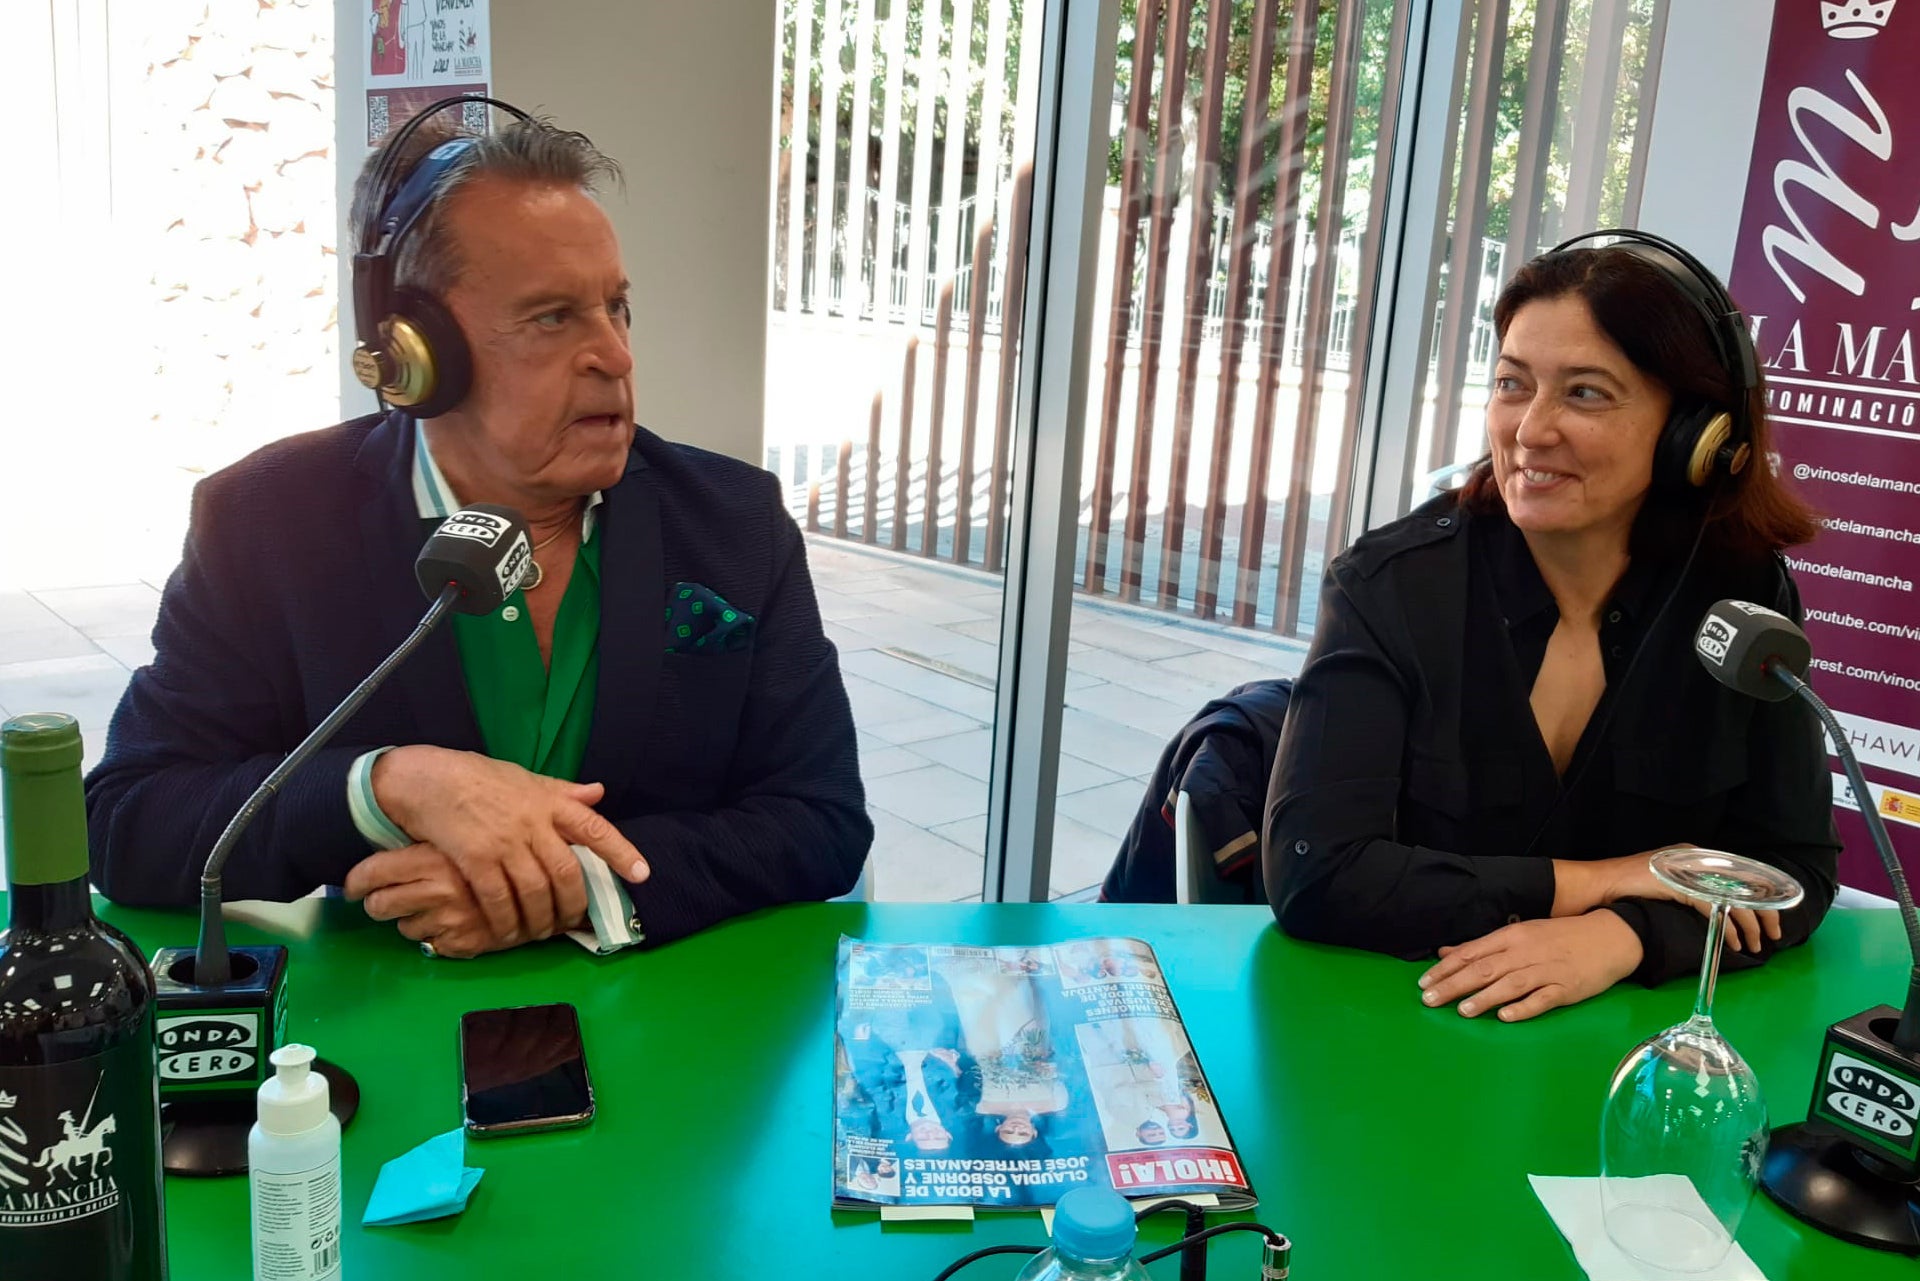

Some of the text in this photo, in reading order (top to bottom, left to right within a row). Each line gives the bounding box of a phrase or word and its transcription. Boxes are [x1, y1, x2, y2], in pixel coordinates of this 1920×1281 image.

[453, 514, 498, 527] ONDA
[449, 524, 489, 537] CERO
[163, 1028, 243, 1046] ONDA
[168, 1055, 242, 1073] CERO
[1840, 1068, 1907, 1107] ONDA
[1840, 1096, 1902, 1131] CERO
[903, 1156, 1089, 1173] JOSÉ ENTRECANALES
[904, 1169, 1088, 1186] CLAUDIA OSBORNE Y
[22, 1176, 118, 1211] MANCHA
[904, 1185, 1012, 1199] LA BODA DE
